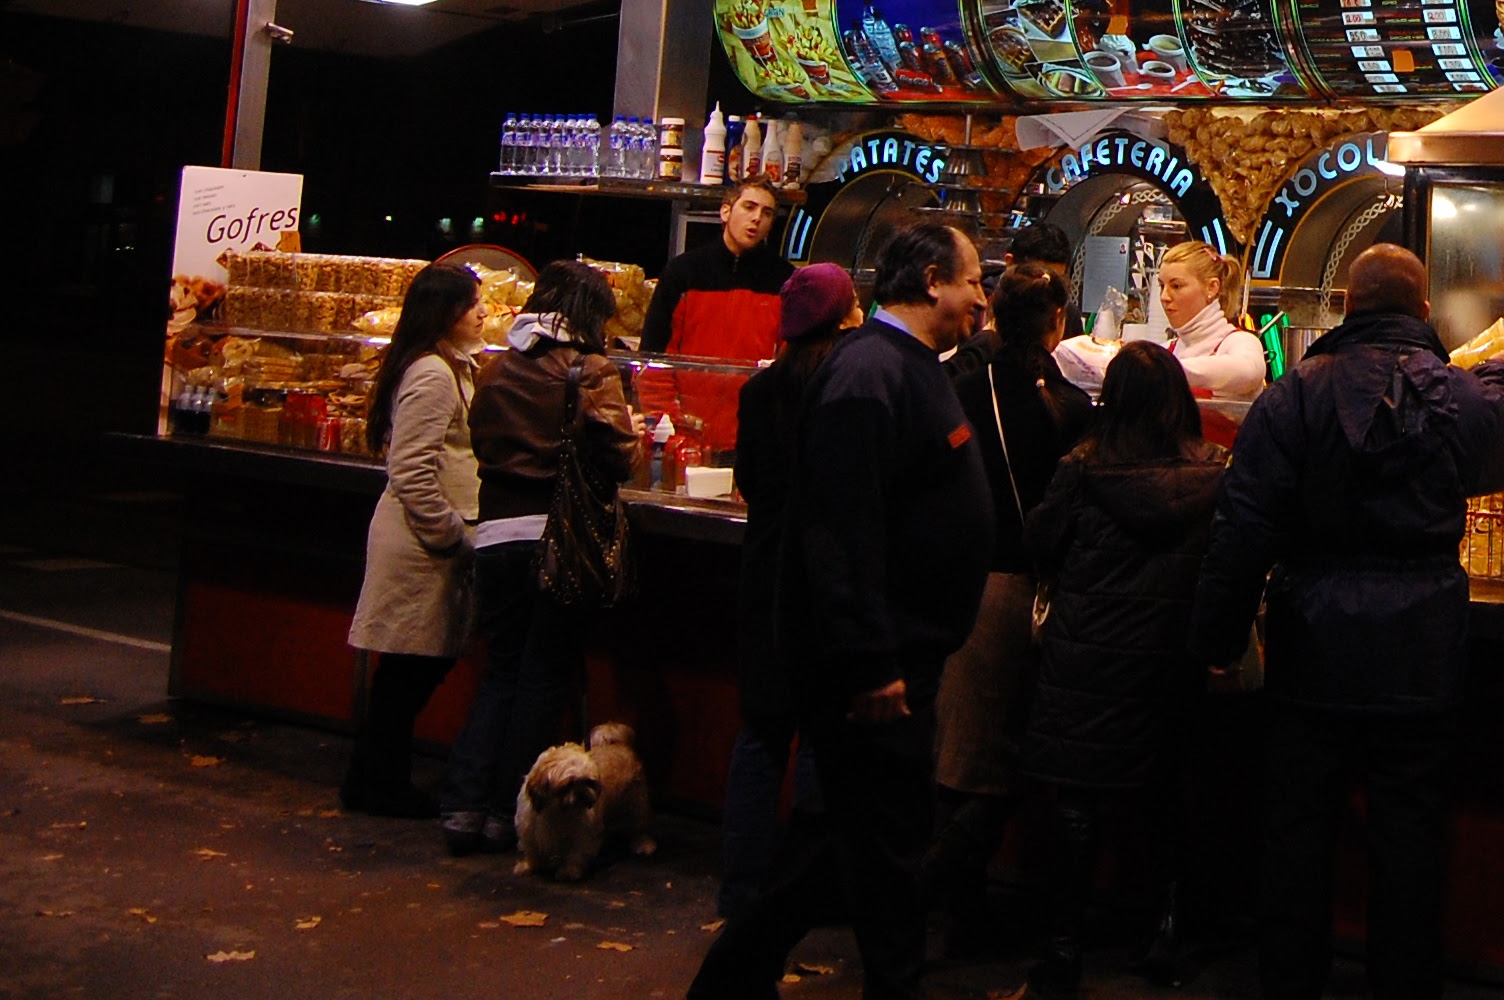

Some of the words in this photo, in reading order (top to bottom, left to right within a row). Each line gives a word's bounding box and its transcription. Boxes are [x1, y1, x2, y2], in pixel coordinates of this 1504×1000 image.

[837, 137, 945, 184] PATATES
[1046, 136, 1194, 197] CAFETERIA
[206, 206, 298, 245] Gofres
